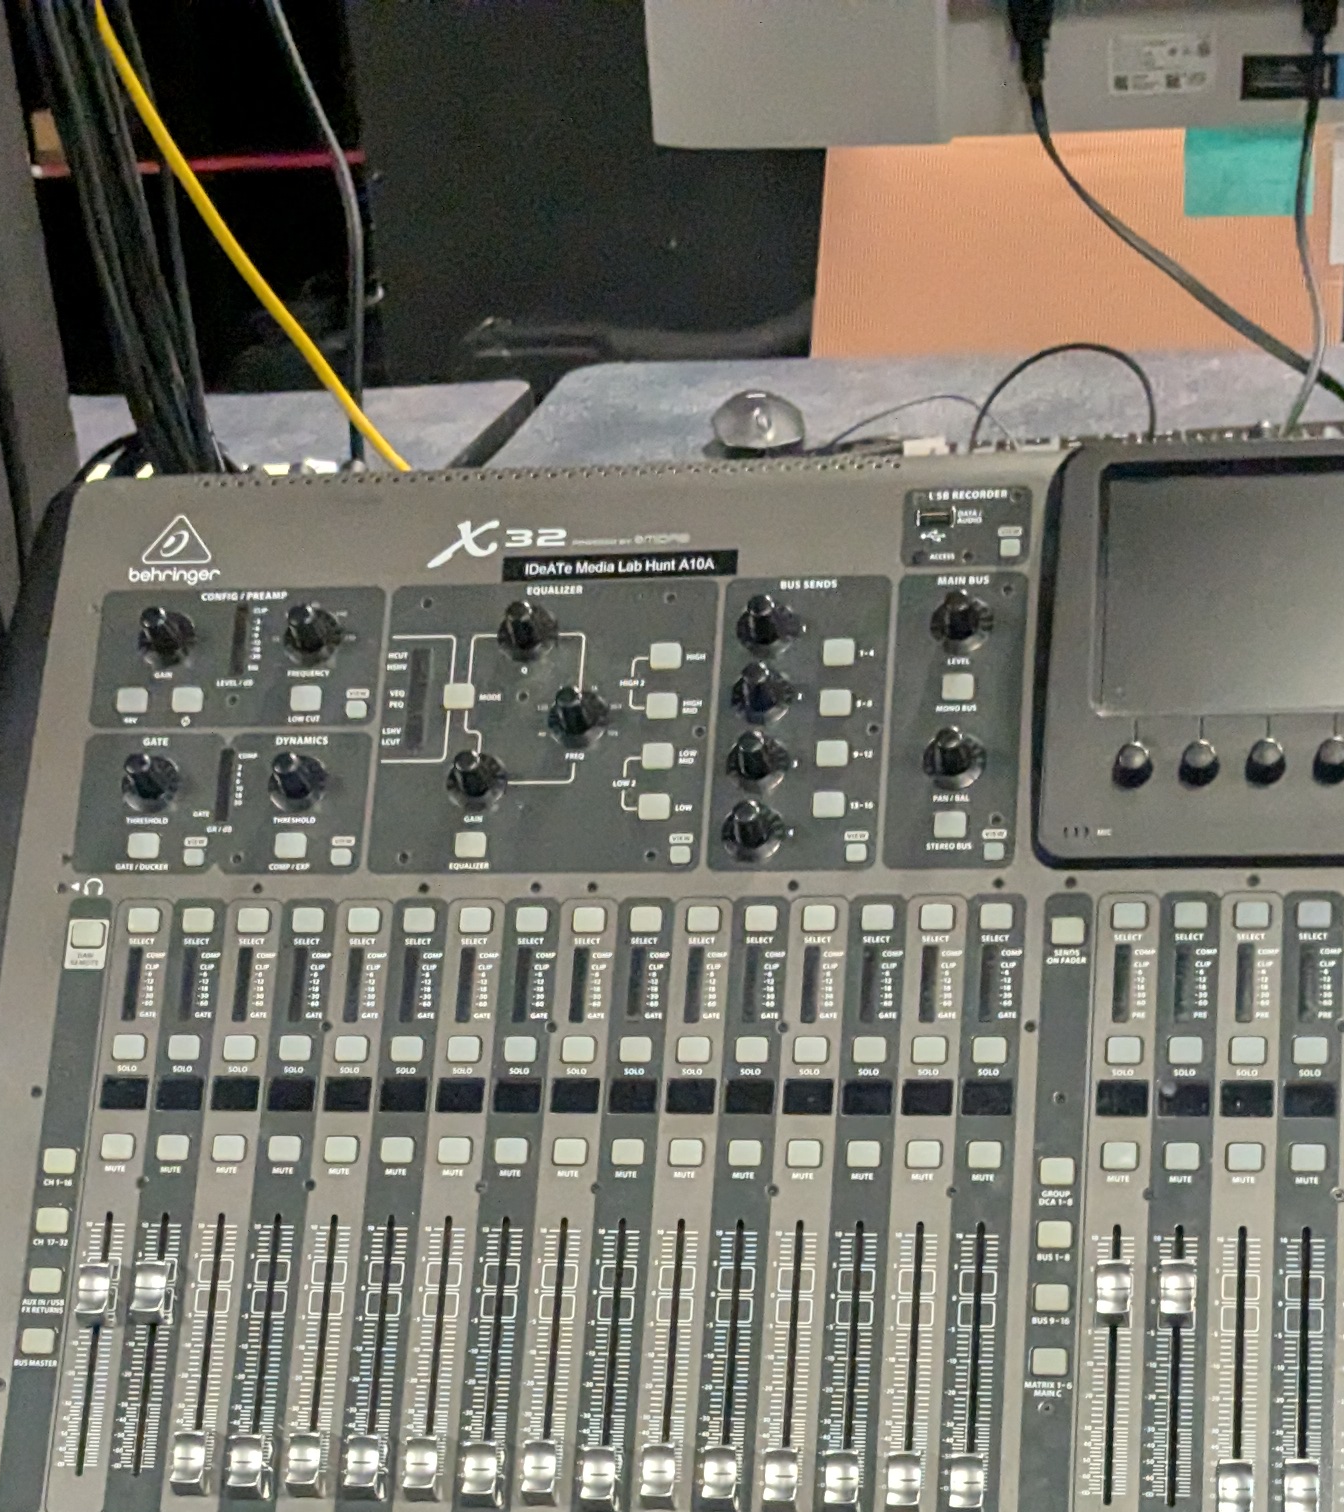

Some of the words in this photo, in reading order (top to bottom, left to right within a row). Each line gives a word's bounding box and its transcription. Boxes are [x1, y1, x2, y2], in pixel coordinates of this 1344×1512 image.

[930, 553, 955, 561] ACCESS
[525, 562, 572, 576] IDeATe
[576, 560, 614, 574] Media
[618, 559, 642, 573] Lab
[646, 559, 676, 573] Hunt
[679, 557, 715, 571] A10A
[129, 567, 220, 585] behringer
[780, 580, 801, 589] BUS
[804, 579, 838, 590] SENDS
[937, 576, 966, 586] MAIN
[968, 575, 990, 585] BUS
[527, 585, 583, 596] EQUALIZER
[686, 653, 706, 661] HIGH
[947, 658, 970, 666] LEVEL
[287, 670, 329, 678] FREQUENCY
[521, 667, 528, 675] Q
[390, 690, 405, 698] VEQ
[479, 693, 502, 701] MODE
[389, 701, 404, 709] PEQ
[936, 704, 960, 713] MONO
[962, 704, 977, 712] BUS
[288, 715, 304, 723] LOW
[306, 715, 320, 723] CUT
[143, 737, 169, 747] GATE
[275, 735, 328, 746] DYNAMICS
[381, 738, 400, 746] LCUT
[565, 752, 584, 761] FREQ
[675, 804, 693, 812] LOW
[126, 816, 168, 825] THRESHOLD
[464, 815, 483, 823] GAIN
[926, 842, 954, 850] STEREO
[956, 842, 972, 850] BUS
[1236, 933, 1265, 941] SELECT
[1047, 957, 1059, 965] ON
[1061, 957, 1087, 965] FADER
[1195, 961, 1212, 969] CLIP
[1041, 1190, 1071, 1198] GROUP
[1039, 1198, 1057, 1206] DCA
[1059, 1198, 1074, 1206] 1-8
[1037, 1253, 1053, 1261] BUS
[1055, 1253, 1070, 1261] 1-8
[1032, 1317, 1048, 1325] BUS
[29, 1359, 58, 1367] MASTER
